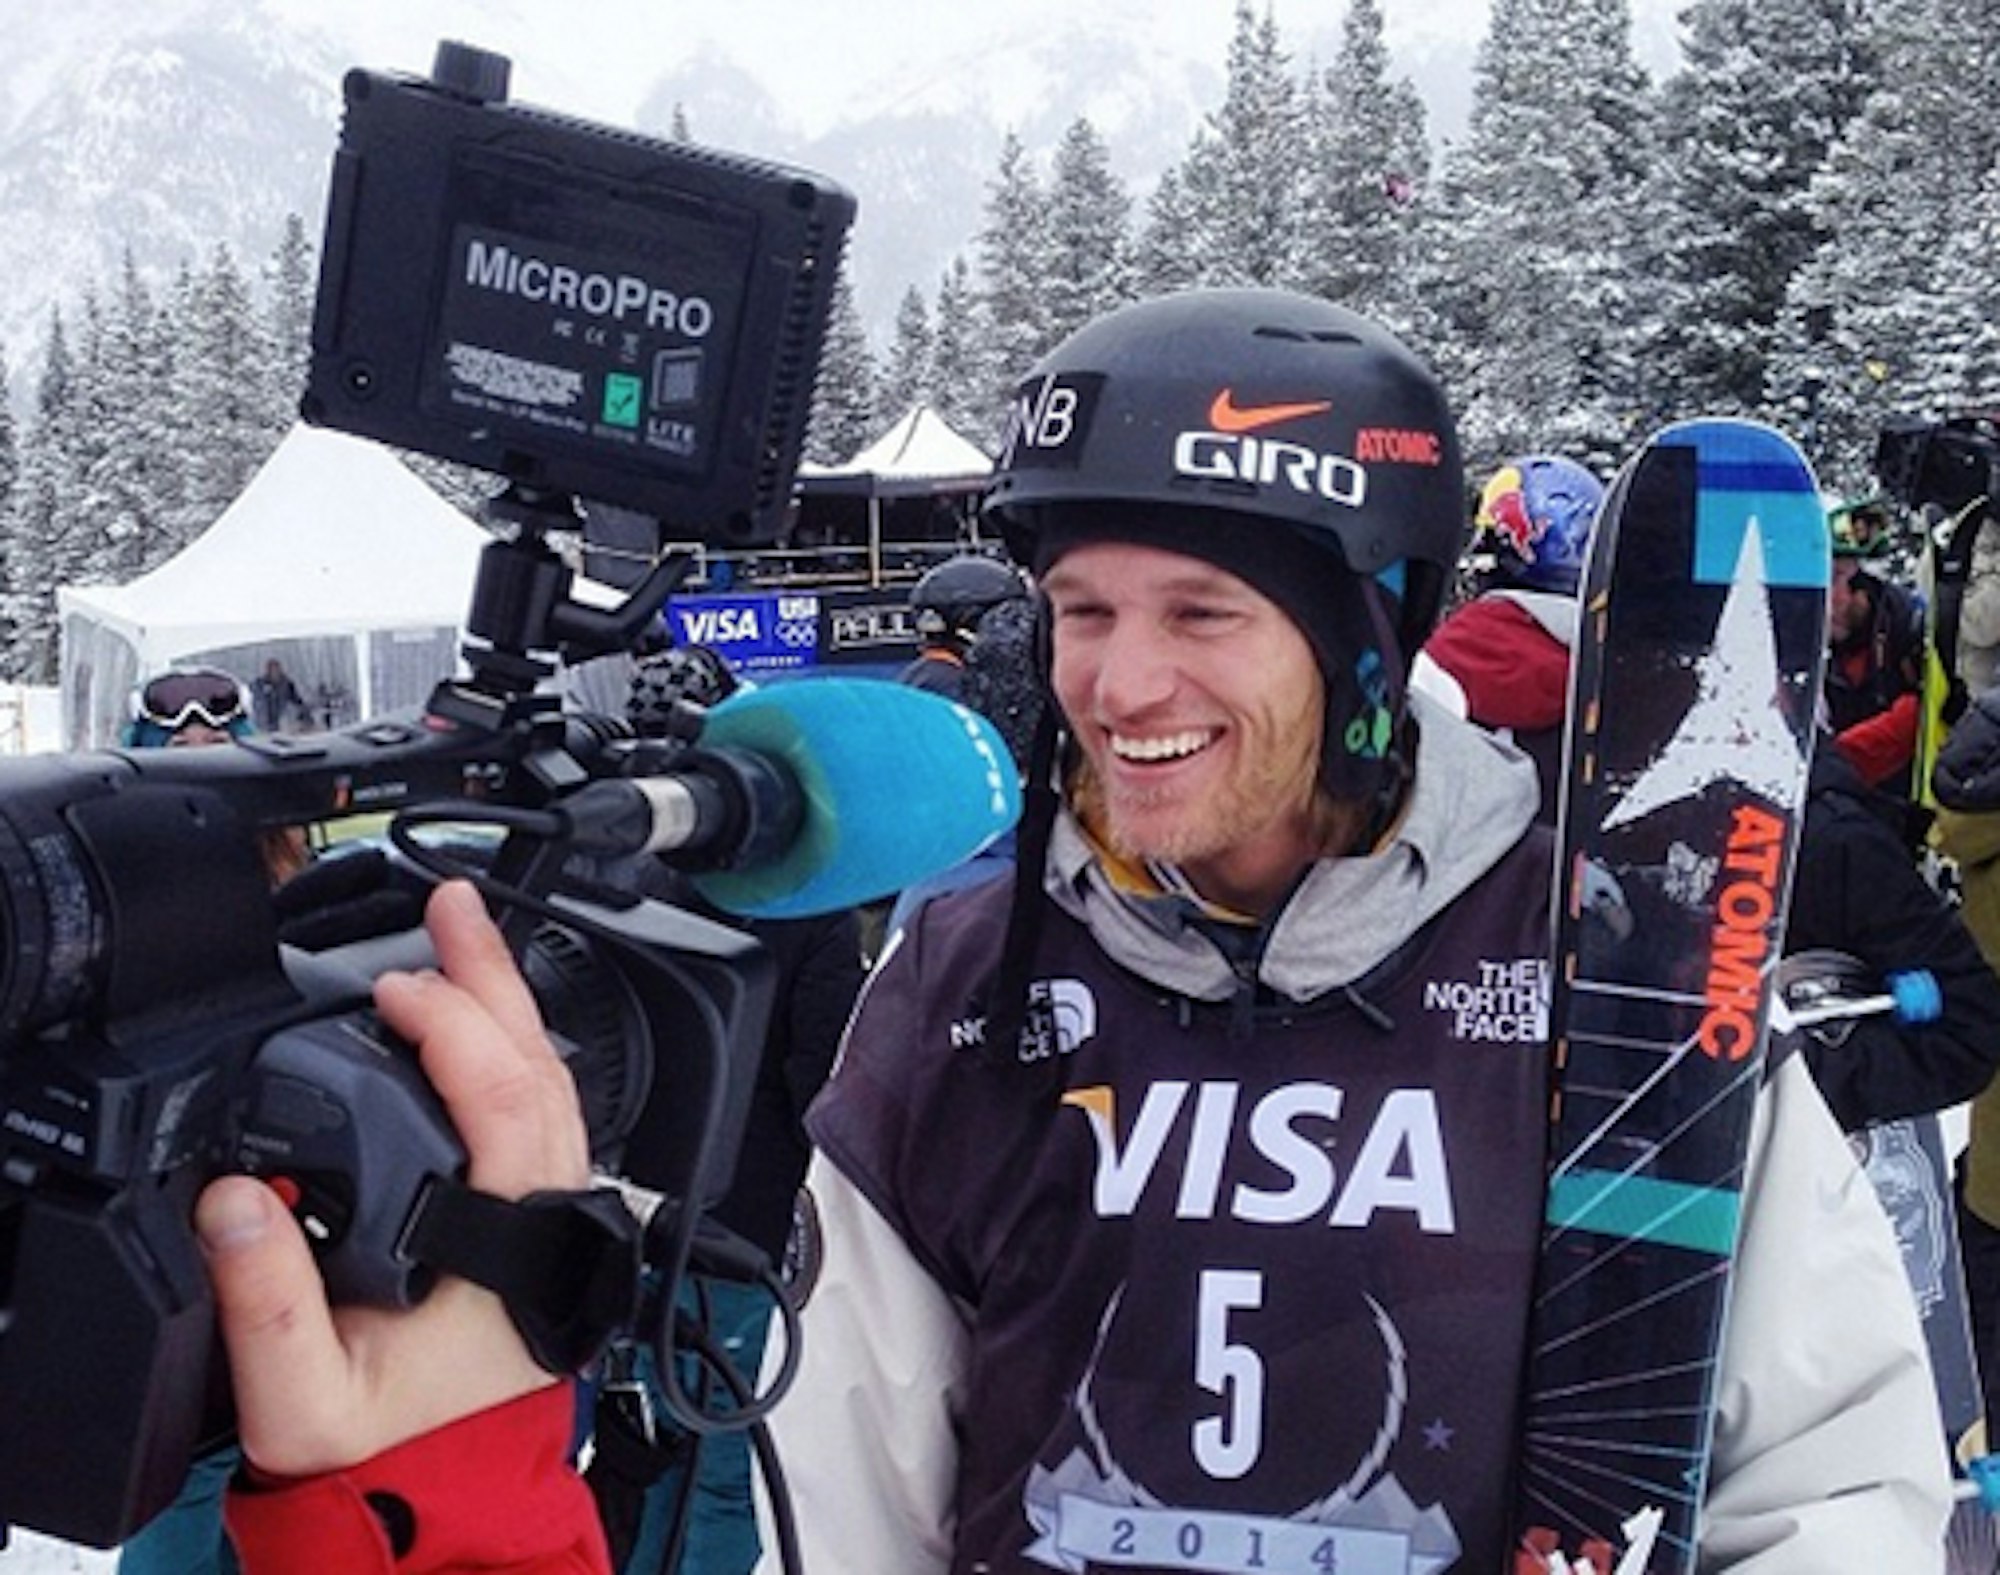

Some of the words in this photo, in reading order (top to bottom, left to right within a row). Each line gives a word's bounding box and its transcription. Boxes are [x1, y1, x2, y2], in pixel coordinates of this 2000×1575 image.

[1174, 431, 1367, 508] GIRO
[1356, 428, 1441, 467] ATOMIC
[680, 608, 760, 644] VISA
[1699, 804, 1785, 1062] ATOMIC
[1478, 959, 1538, 987] THE
[1423, 981, 1537, 1014] NORTH
[1454, 1011, 1537, 1042] FACE
[1061, 1080, 1456, 1236] VISA
[1191, 1268, 1264, 1480] 5
[1111, 1519, 1337, 1575] 2014
